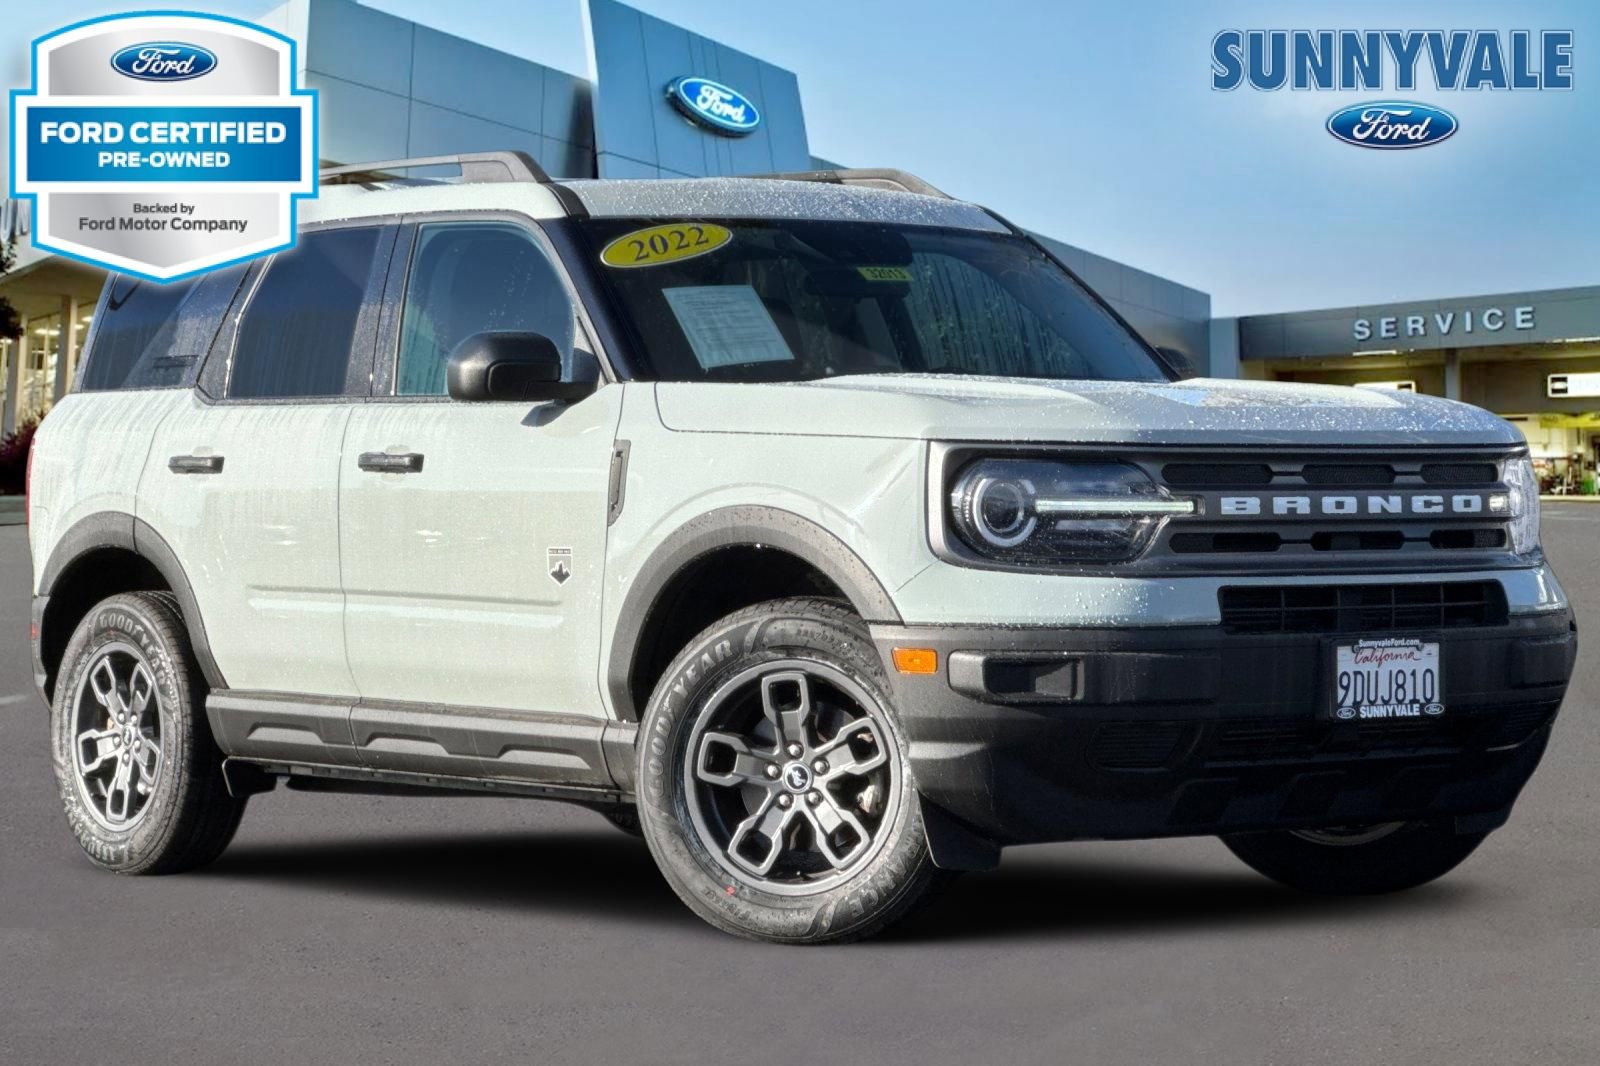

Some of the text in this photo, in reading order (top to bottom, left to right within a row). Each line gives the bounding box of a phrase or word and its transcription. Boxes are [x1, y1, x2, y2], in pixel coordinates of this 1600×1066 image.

[696, 84, 747, 123] Ford
[627, 226, 710, 262] 2022
[1352, 305, 1536, 341] SERVICE
[1220, 494, 1482, 515] BRONCO
[1354, 647, 1422, 667] California
[1339, 668, 1435, 705] 9DUJ810
[648, 638, 733, 797] GOODYEAR
[1359, 703, 1421, 719] SUNNYVALE
